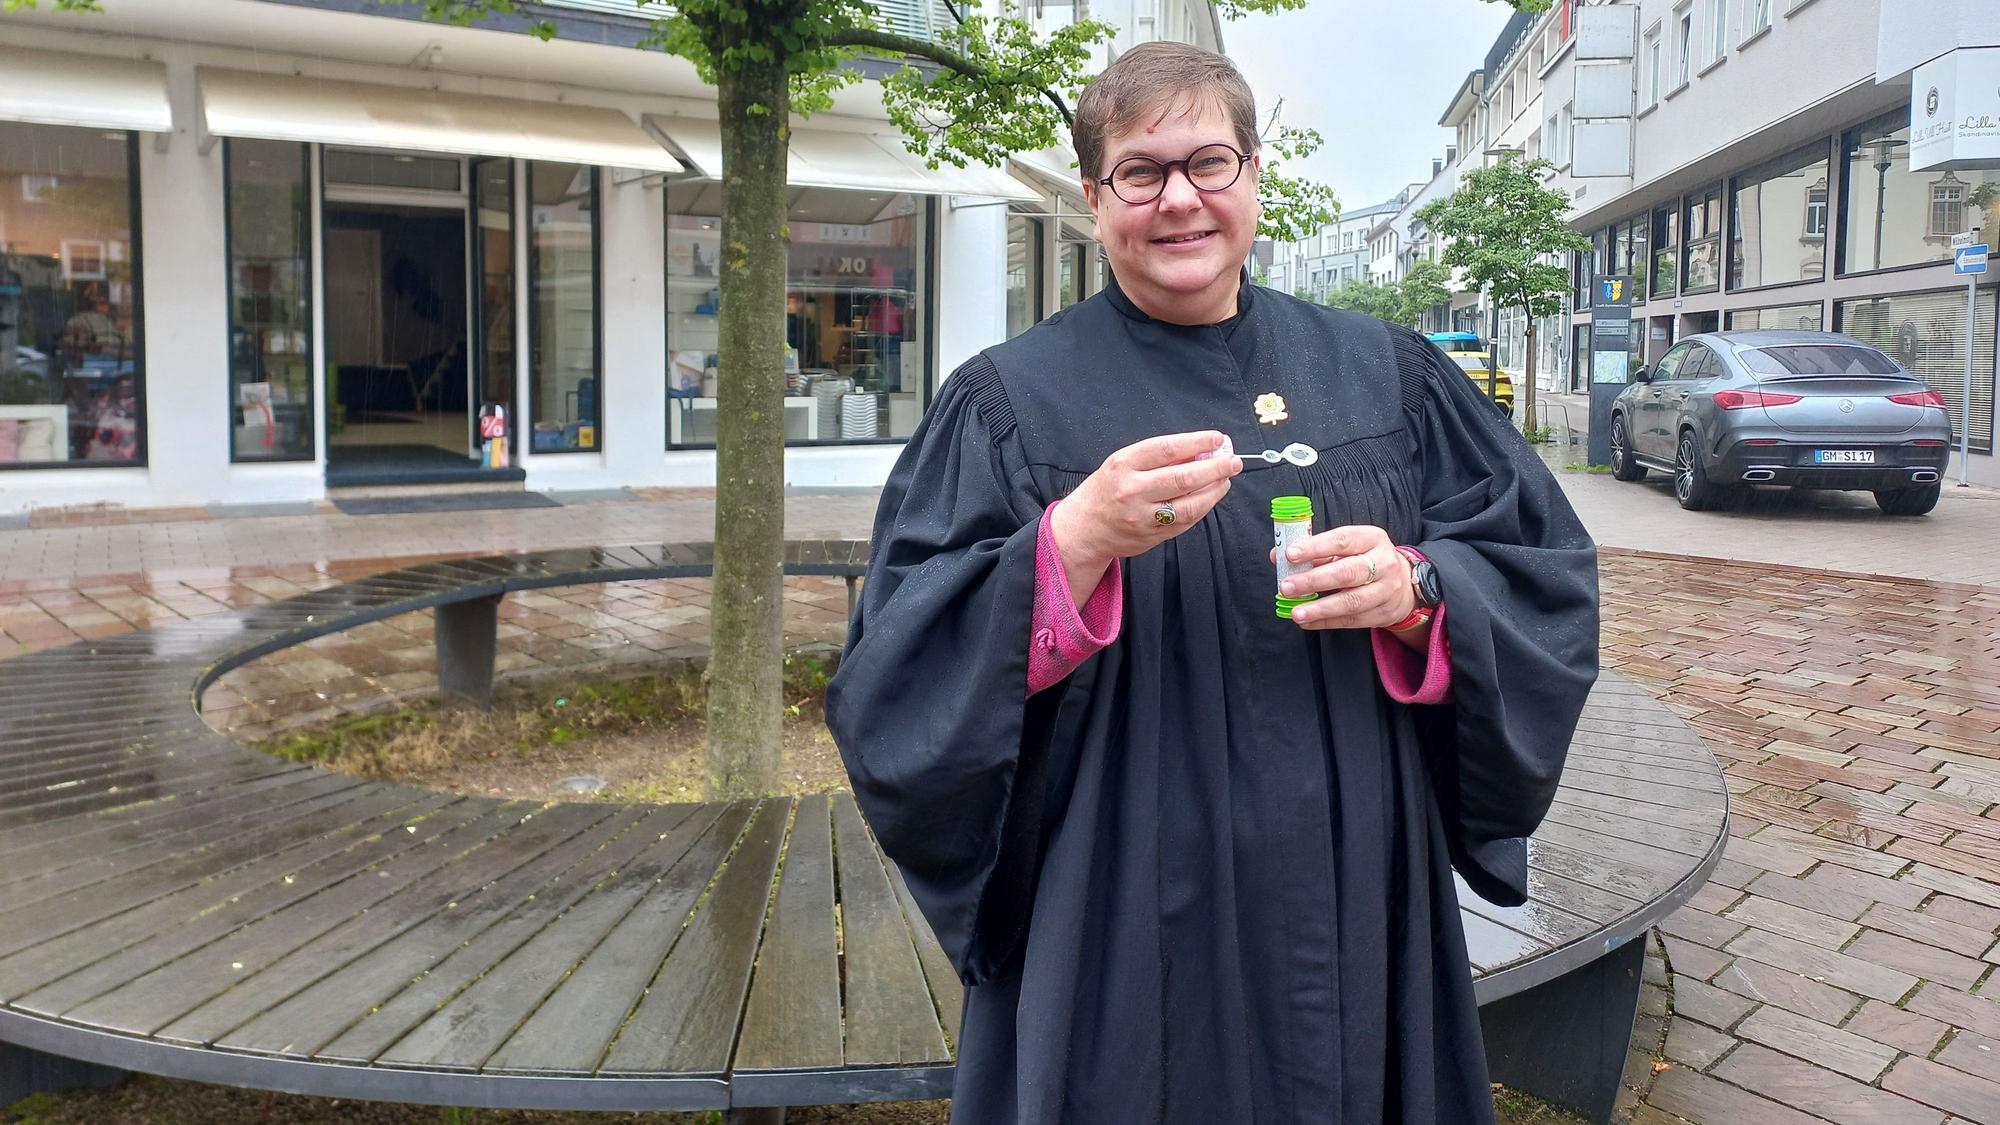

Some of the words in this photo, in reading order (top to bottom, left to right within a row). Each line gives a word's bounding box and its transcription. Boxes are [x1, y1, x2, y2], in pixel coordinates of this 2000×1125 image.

[1958, 115, 1997, 130] Lilla
[481, 416, 504, 437] %
[1822, 451, 1837, 462] GM
[1844, 451, 1857, 462] SI
[1859, 451, 1873, 462] 17
